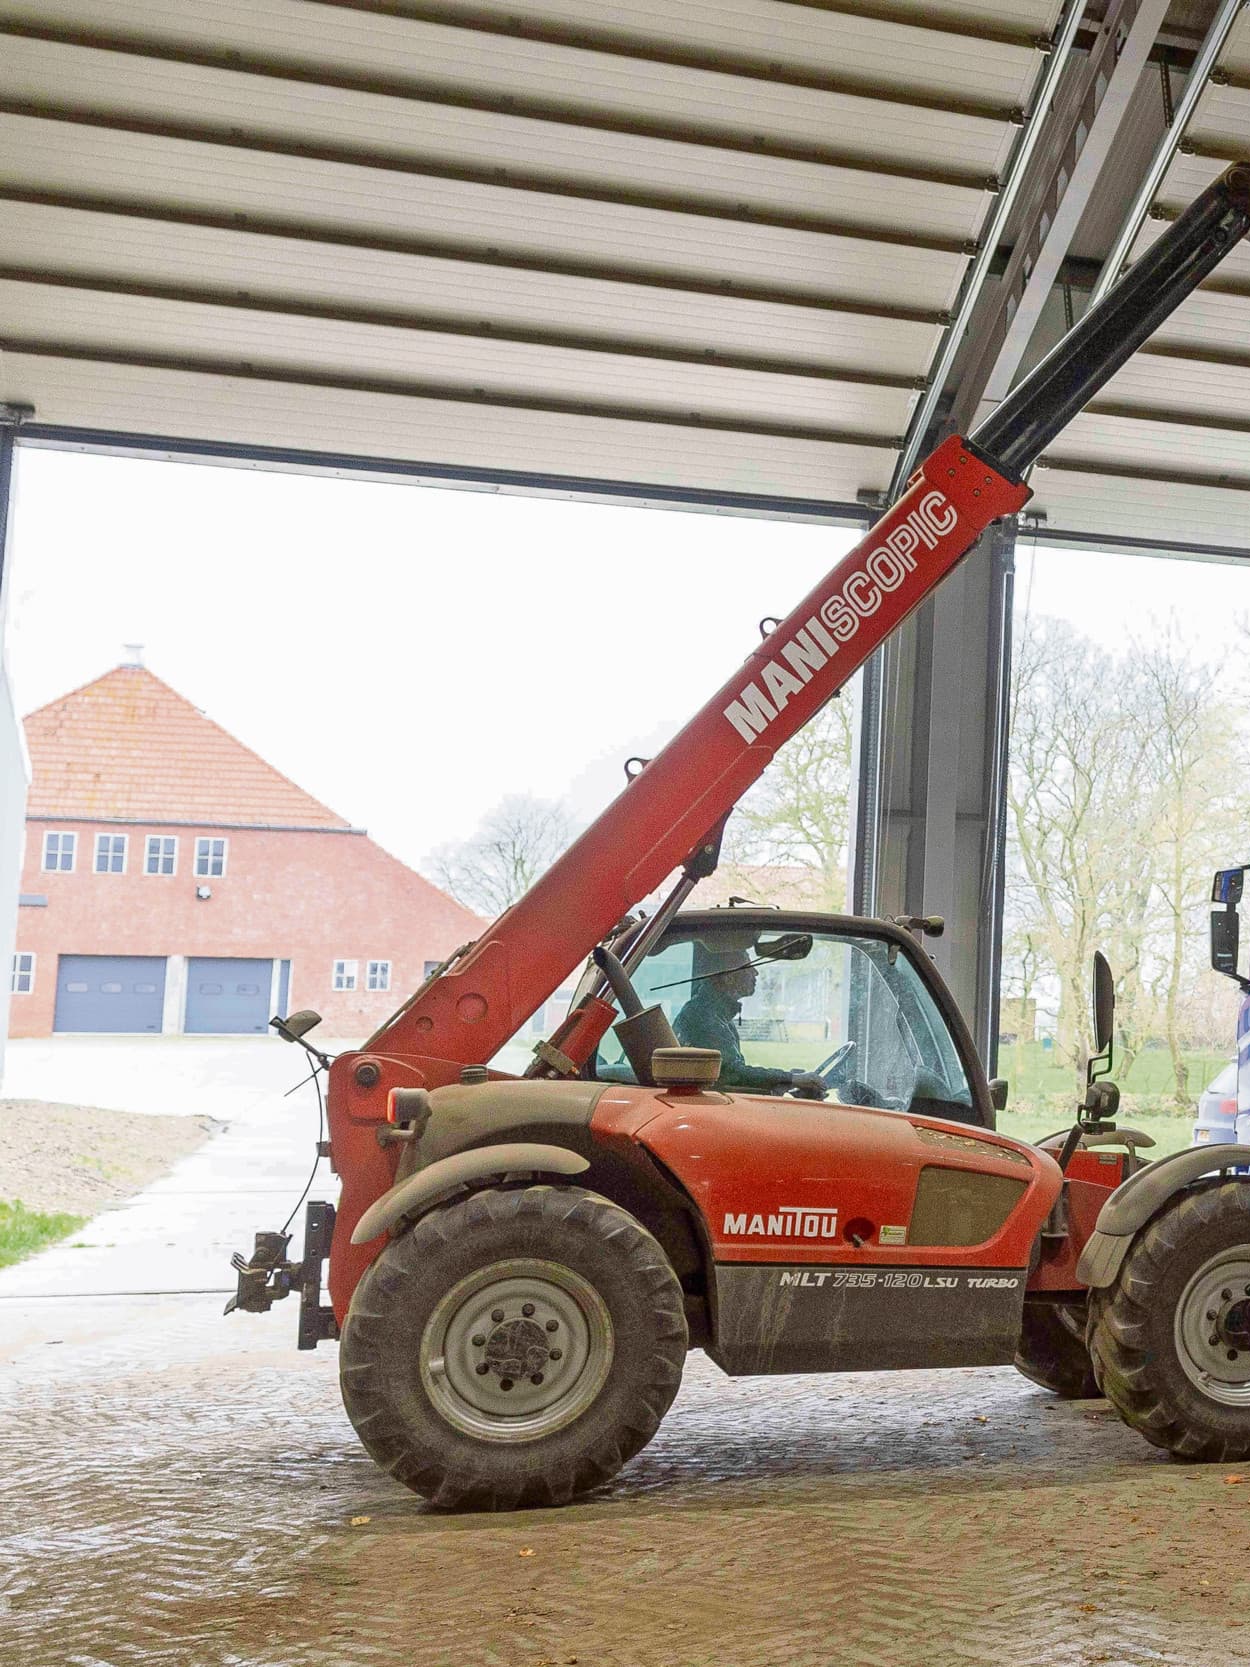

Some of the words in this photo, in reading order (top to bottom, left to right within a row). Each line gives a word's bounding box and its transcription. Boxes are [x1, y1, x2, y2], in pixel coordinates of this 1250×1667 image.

[723, 491, 958, 744] MANISCOPIC
[723, 1207, 838, 1238] MANITOU
[779, 1272, 831, 1287] MLT
[967, 1278, 1019, 1289] TURBO
